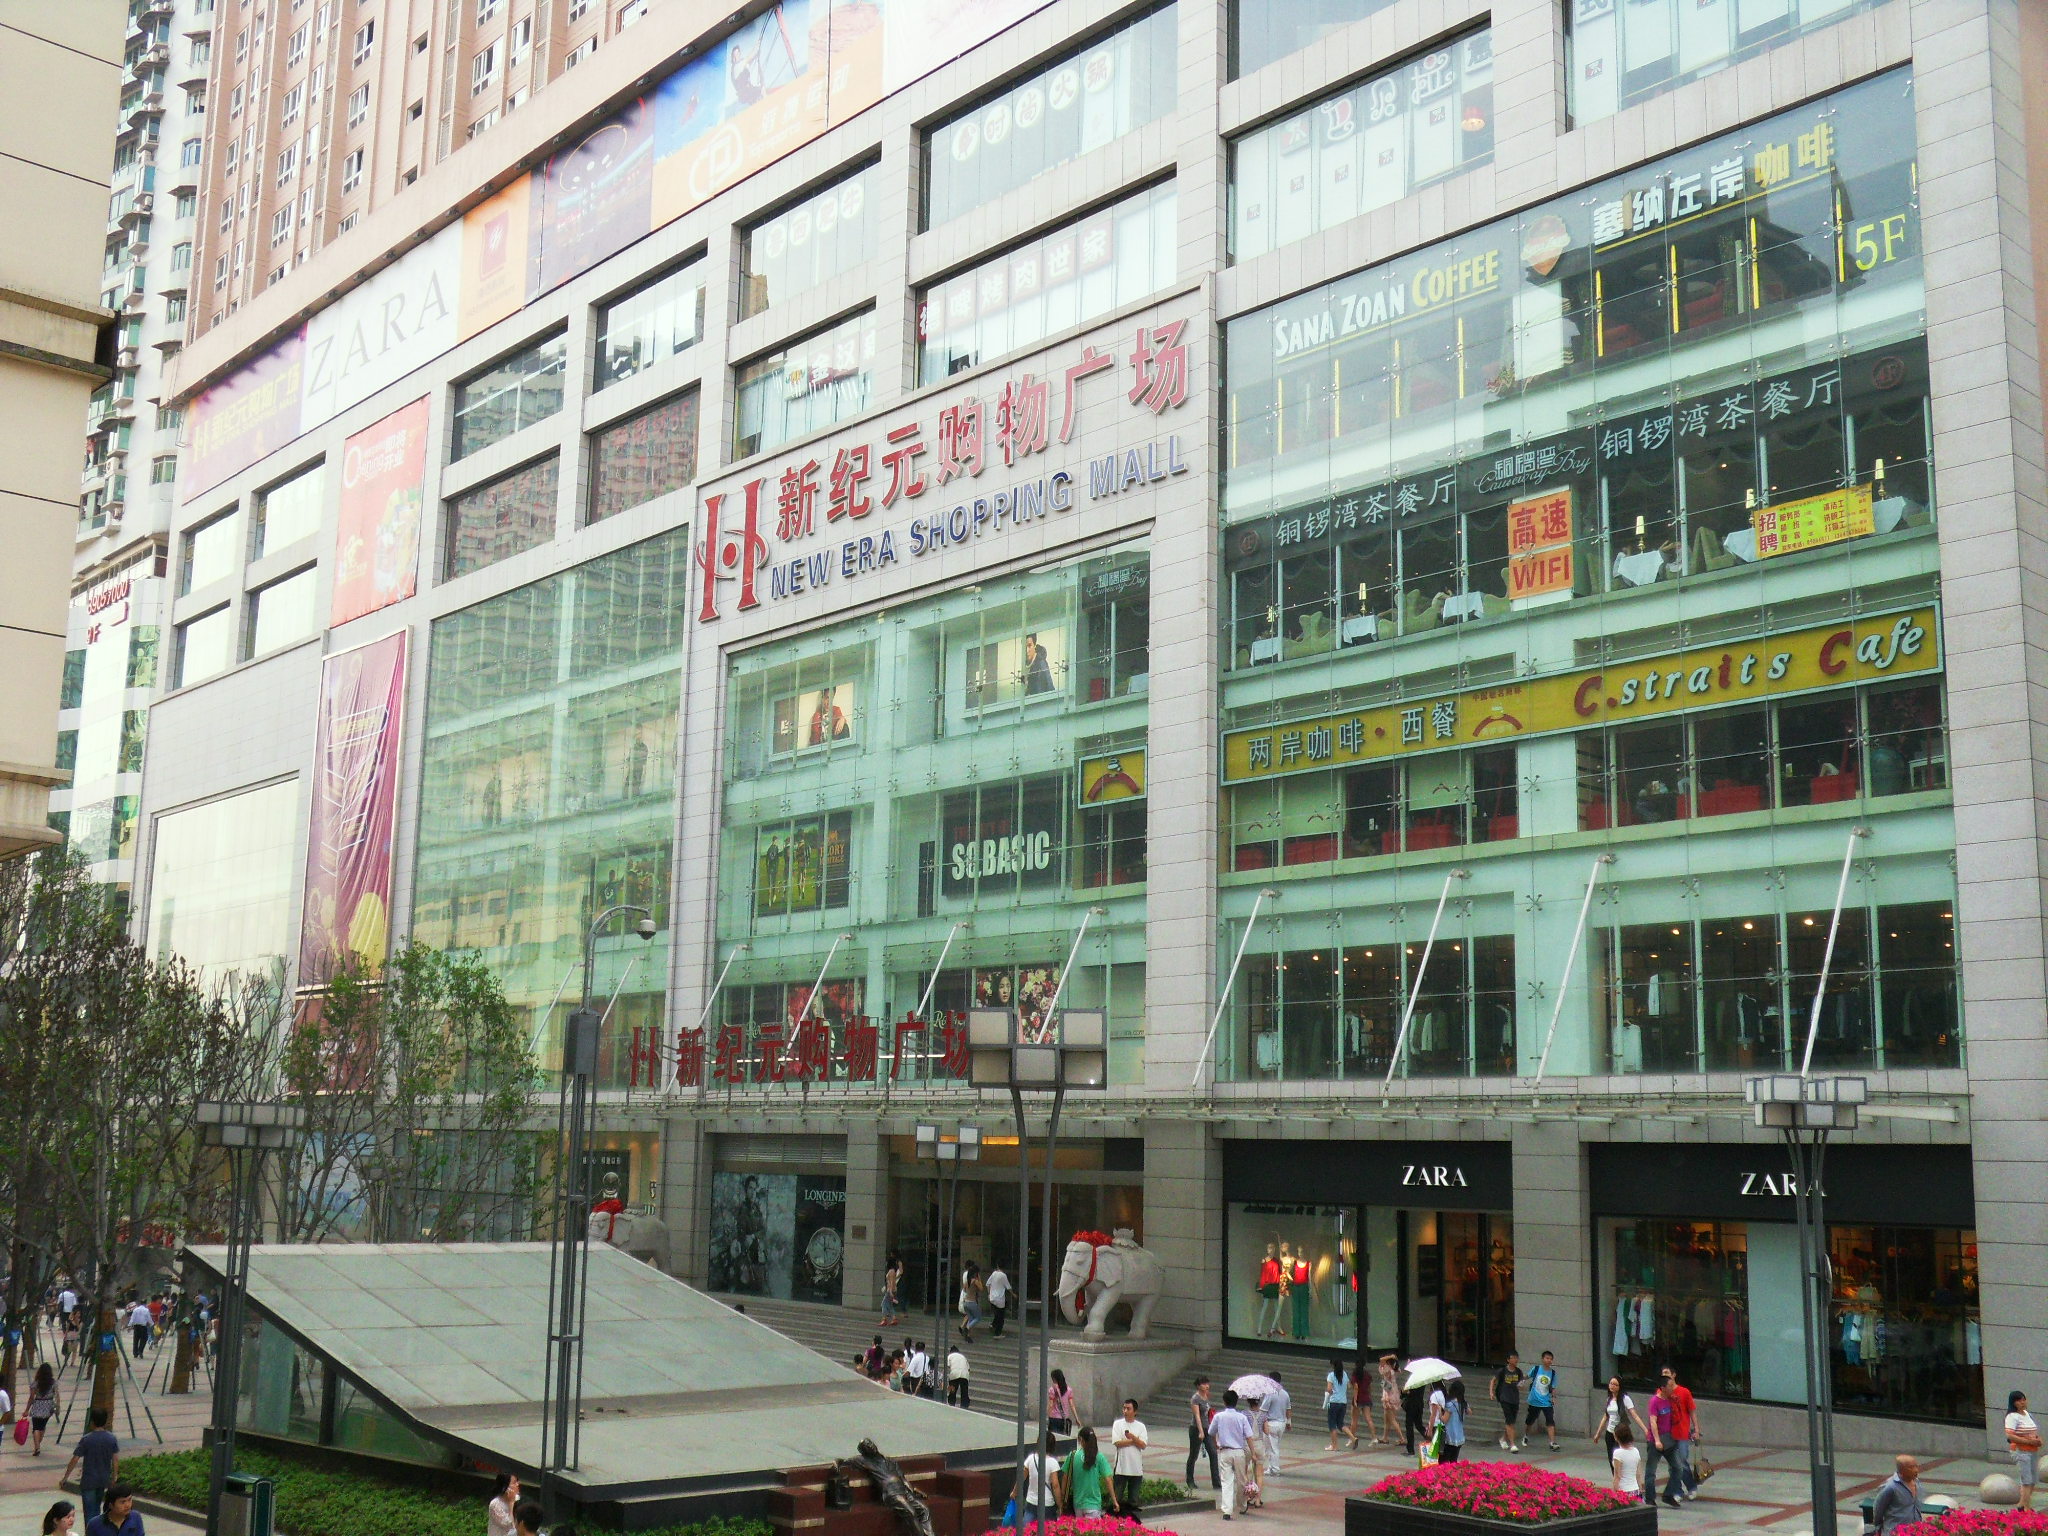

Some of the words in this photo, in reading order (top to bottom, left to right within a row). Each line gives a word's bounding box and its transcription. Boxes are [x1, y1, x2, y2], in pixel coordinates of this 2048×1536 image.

[1593, 121, 1834, 246] 塞纳左岸咖啡
[1856, 214, 1905, 271] 5F
[308, 269, 449, 397] ZARA
[1275, 311, 1334, 357] SANA
[1340, 283, 1404, 335] ZOAN
[1412, 249, 1498, 308] COFFEE
[776, 319, 1189, 542] 新纪元购物广场
[1599, 369, 1842, 460] 铜锣湾茶餐厅
[1553, 446, 1591, 474] Bay
[771, 549, 831, 600] NEW
[842, 530, 897, 576] ERA
[909, 471, 1073, 555] SHOPPING
[1089, 435, 1187, 500] MALL
[1276, 474, 1456, 547] 铜锣湾茶餐厅
[1510, 498, 1568, 549] 高速
[1759, 512, 1779, 553] 招聘
[1512, 555, 1570, 592] WIFI
[1819, 616, 1925, 676] Cafe
[1247, 719, 1365, 771] 两岸咖啡
[1401, 701, 1457, 745] 西餐
[676, 1010, 970, 1088] 新纪元购物广场
[1402, 1165, 1468, 1187] ZARA
